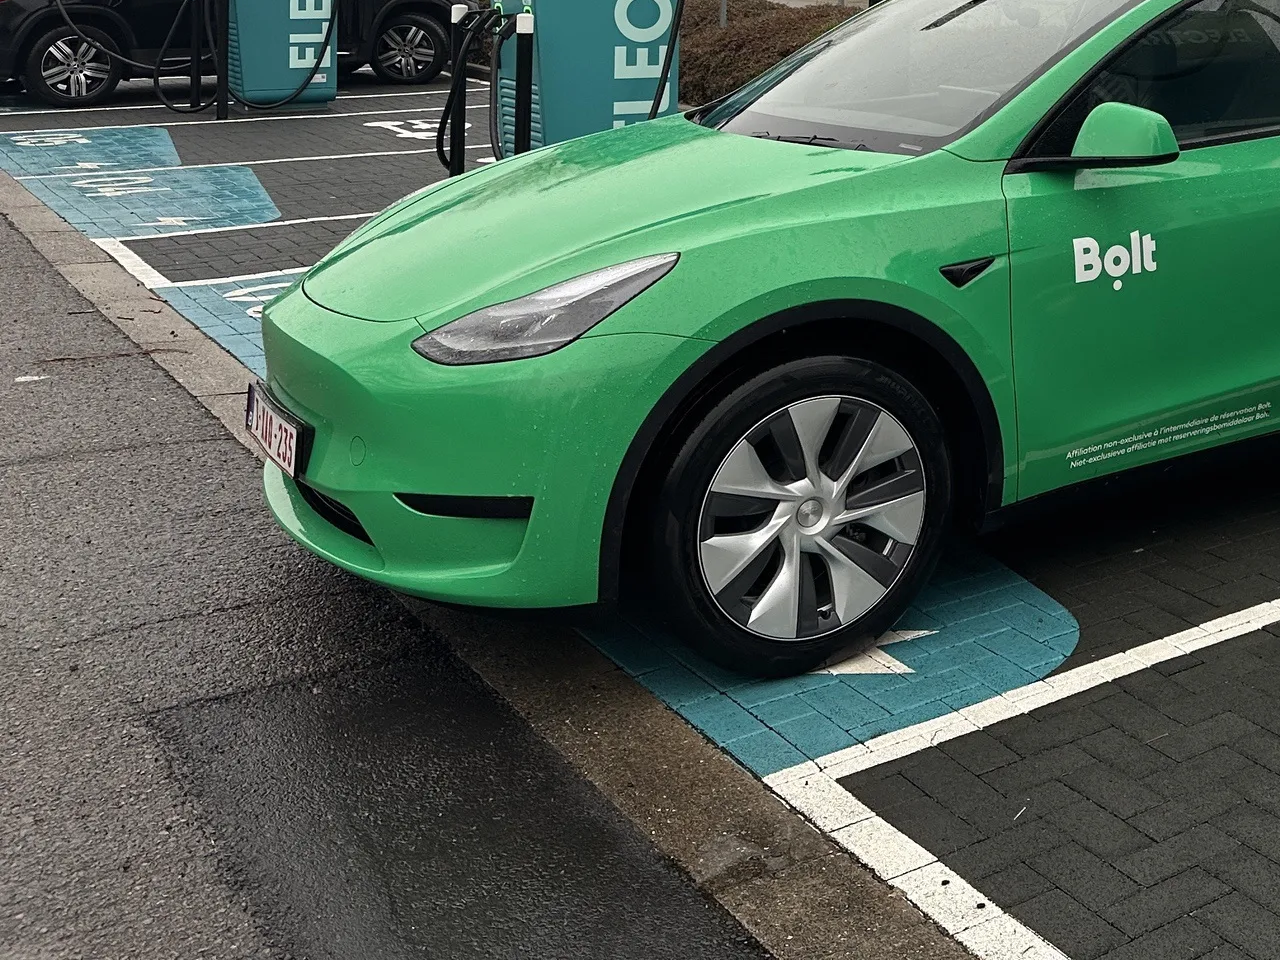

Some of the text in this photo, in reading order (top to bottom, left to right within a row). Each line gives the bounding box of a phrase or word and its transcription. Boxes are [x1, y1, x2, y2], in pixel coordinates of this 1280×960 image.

[1072, 229, 1157, 291] Bolt
[1065, 443, 1103, 460] Affiliation
[1103, 431, 1152, 449] non-exclusive
[1210, 414, 1219, 423] de
